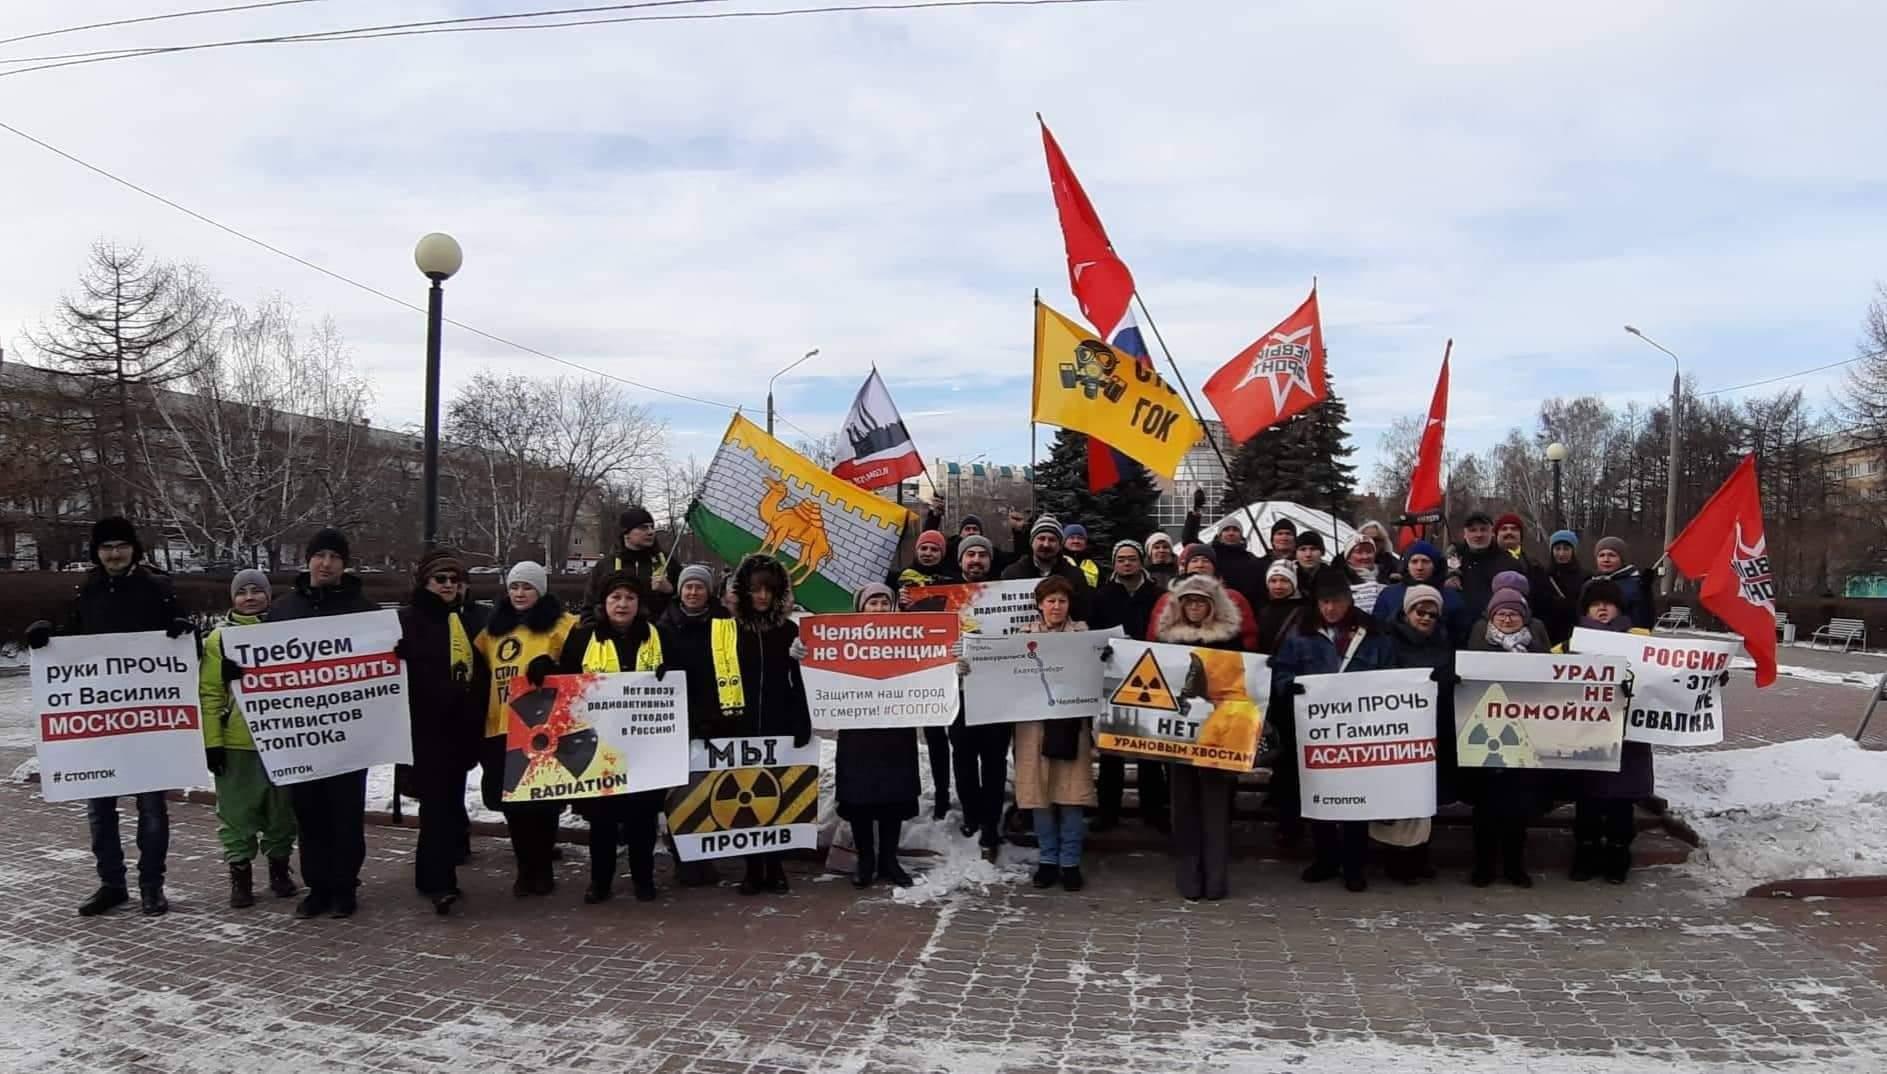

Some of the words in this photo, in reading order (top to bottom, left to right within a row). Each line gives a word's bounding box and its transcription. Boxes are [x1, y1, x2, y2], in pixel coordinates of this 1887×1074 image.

[1130, 397, 1179, 443] ГОК
[813, 622, 926, 642] Челябинск
[235, 637, 354, 666] Требуем
[813, 647, 839, 662] не
[843, 643, 948, 664] Освенцим
[1642, 645, 1729, 671] РОССИЯ
[47, 664, 98, 685] руки
[105, 656, 188, 677] ПРОЧЬ
[244, 660, 398, 691] остановить
[1552, 664, 1615, 682] УРАЛ
[48, 692, 77, 708] от
[79, 685, 181, 706] Василия
[245, 681, 400, 715] преследование
[623, 685, 642, 696] Нет
[644, 686, 675, 697] ввозу
[815, 687, 874, 704] Защитим
[877, 689, 903, 701] наш
[907, 686, 946, 703] город
[1584, 687, 1615, 703] НЕ
[587, 700, 675, 711] радиоактивных
[813, 707, 829, 718] от
[831, 704, 882, 721] смерти!
[883, 703, 949, 719] #СТОПГОК
[1308, 699, 1353, 719] руки
[1357, 693, 1429, 713] ПРОЧЬ
[1487, 701, 1612, 723] ПОМОЙКА
[48, 710, 192, 738] МОСКОВЦА
[249, 707, 363, 733] активистов
[631, 712, 676, 722] отходов
[1157, 717, 1200, 739] НЕТ
[1631, 708, 1715, 732] СВАЛКА
[622, 727, 628, 736] в
[630, 723, 676, 736] Россию!
[1309, 724, 1333, 741] от
[1336, 720, 1409, 740] Гамиля
[256, 729, 346, 753] топГОКа
[1114, 737, 1187, 755] УРАНОВЫМ
[706, 739, 778, 769] МЫ
[1310, 741, 1437, 765] АСАТУЛЛИНА
[53, 771, 62, 784] #
[65, 768, 117, 783] стопгок
[530, 774, 629, 801] RADIATION
[1312, 795, 1321, 805] #
[1322, 795, 1367, 807] стопгок
[701, 828, 792, 855] ПРОТИВ
